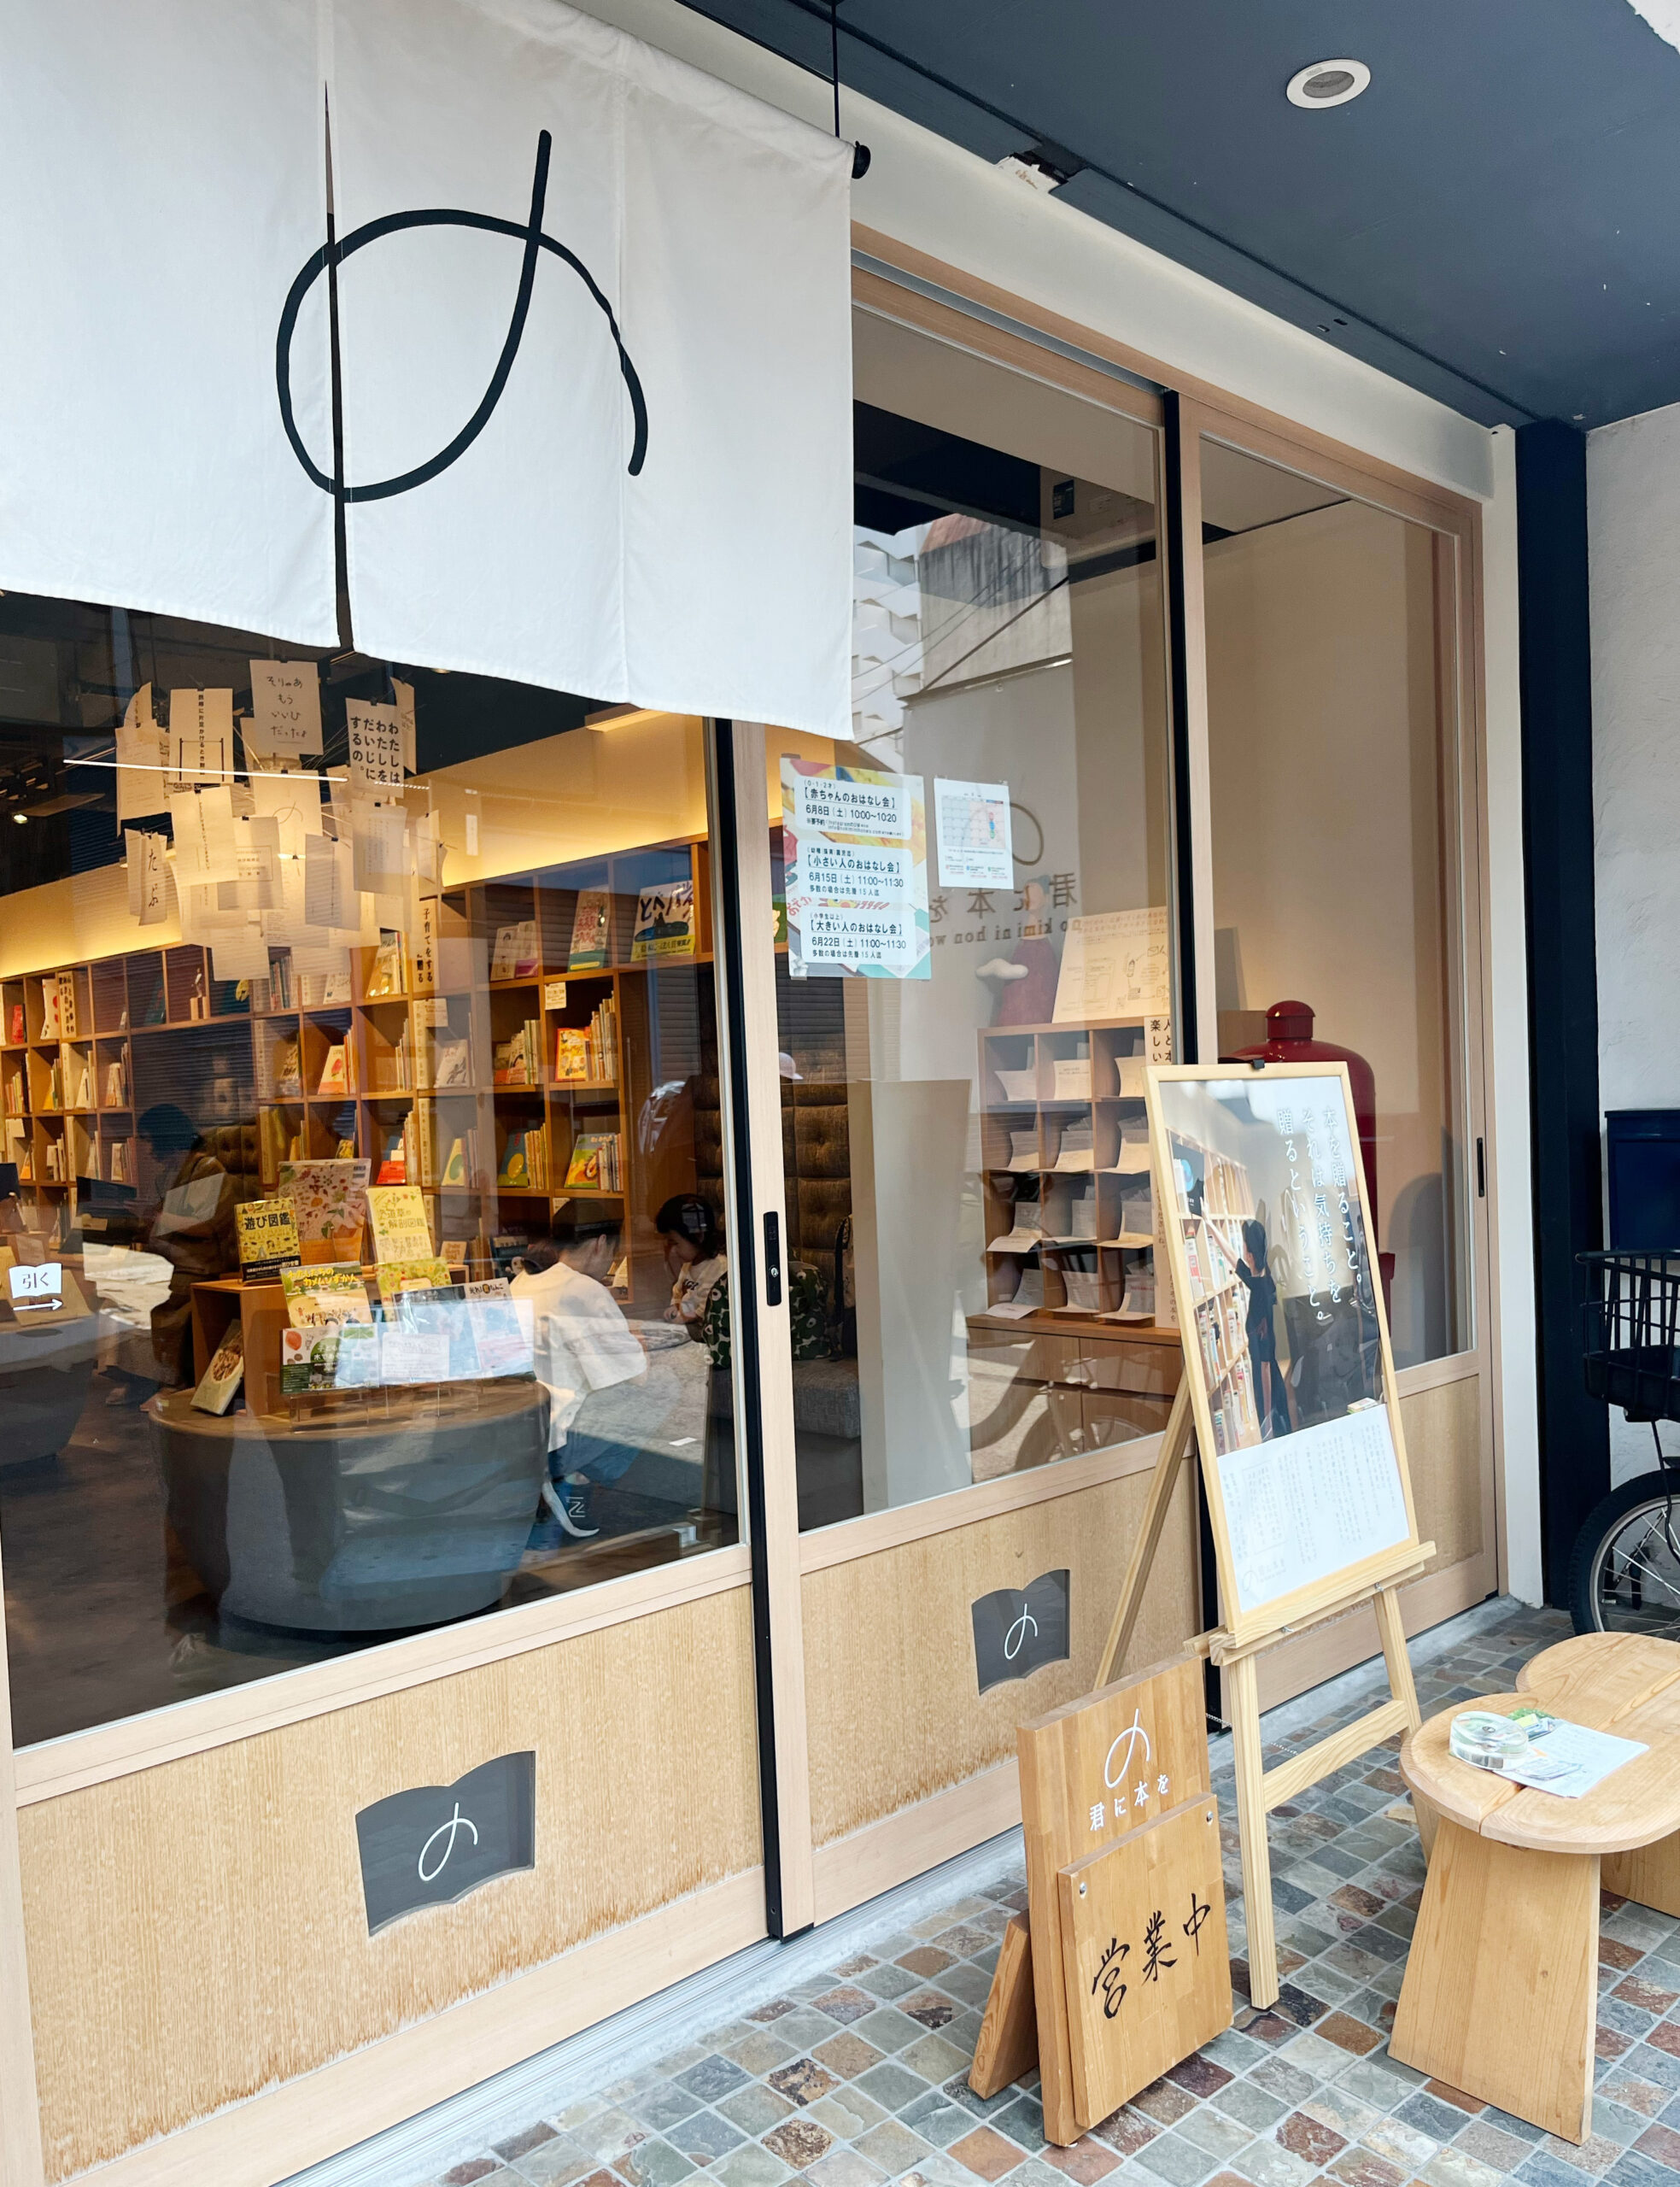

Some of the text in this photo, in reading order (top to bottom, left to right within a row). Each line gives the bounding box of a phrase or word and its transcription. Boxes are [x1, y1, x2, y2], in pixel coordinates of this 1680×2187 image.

[278, 694, 293, 705] もう
[351, 717, 365, 771] するの。
[364, 718, 376, 780] だいじに
[376, 720, 388, 783] わたしを
[389, 722, 401, 783] わたしは
[805, 787, 895, 809] 【赤ちゃんのおはなし会】
[808, 854, 900, 873] 【小さい人のおはなし会】
[811, 919, 902, 935] 【大きい人のおはなし会】
[244, 1211, 291, 1231] 遊び図鑑
[1278, 1111, 1325, 1320] 贈るということ。
[1302, 1110, 1342, 1304] それは気持ちを
[1325, 1110, 1362, 1283] 本を贈ること。
[22, 1271, 50, 1289] 引く
[1089, 1774, 1169, 1831] 君に本を
[1092, 1892, 1211, 2019] 営業中
